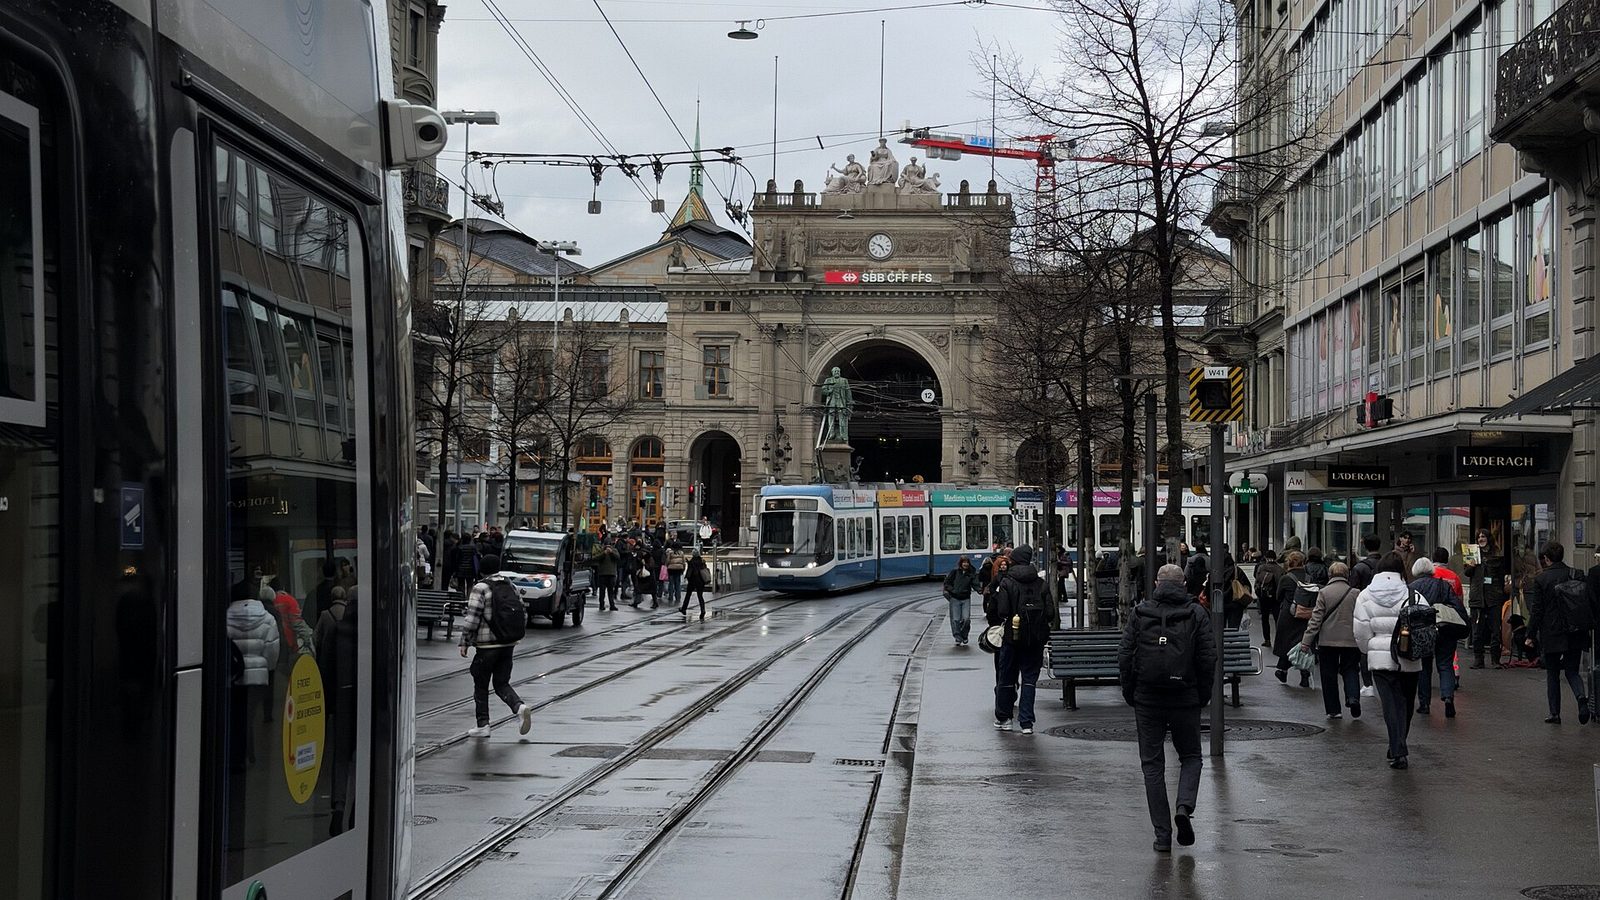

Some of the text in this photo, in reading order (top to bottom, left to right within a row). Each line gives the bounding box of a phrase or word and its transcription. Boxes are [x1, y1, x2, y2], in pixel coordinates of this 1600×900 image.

[862, 273, 933, 282] SBB CFF FFS
[1462, 456, 1533, 466] LÄDERACH
[1332, 472, 1385, 481] LÄDERACH
[943, 494, 965, 502] Medizin
[966, 494, 976, 502] und
[976, 494, 1007, 502] Gesundheit
